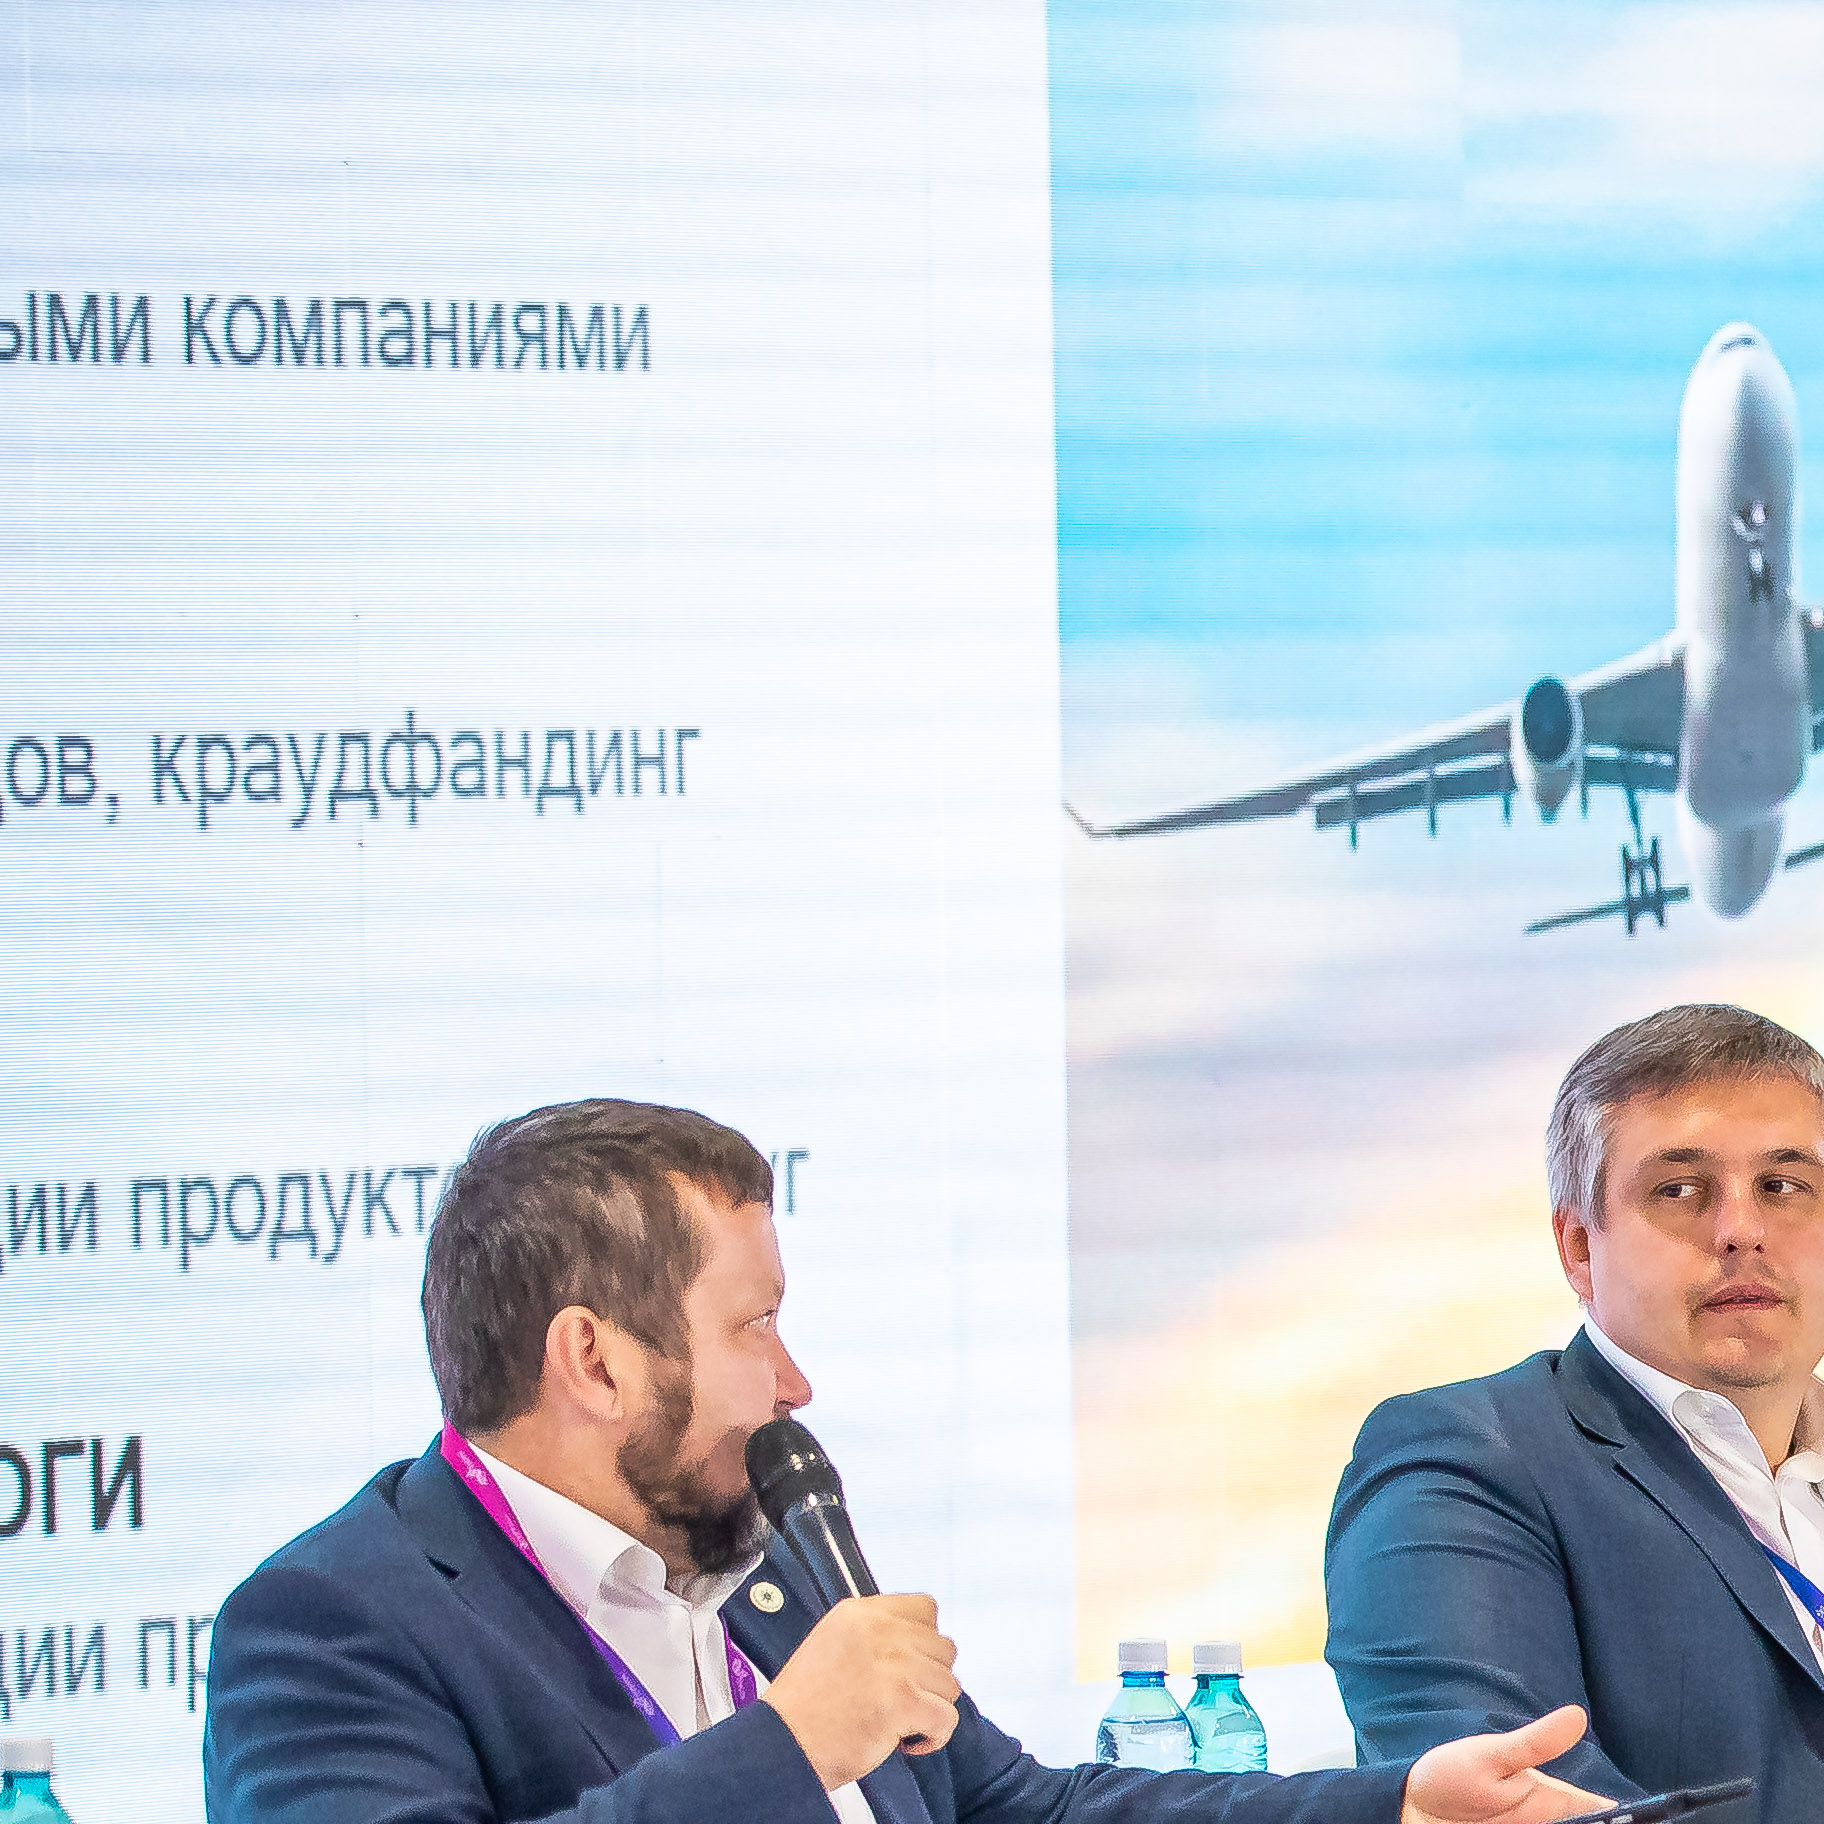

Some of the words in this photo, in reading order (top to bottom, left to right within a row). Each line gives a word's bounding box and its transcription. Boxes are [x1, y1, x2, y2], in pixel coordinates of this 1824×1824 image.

[184, 293, 651, 372] компаниями
[0, 733, 120, 827] ов,
[152, 709, 702, 831] краудфандинг
[0, 1181, 99, 1276] ии
[130, 1162, 450, 1275] продукт
